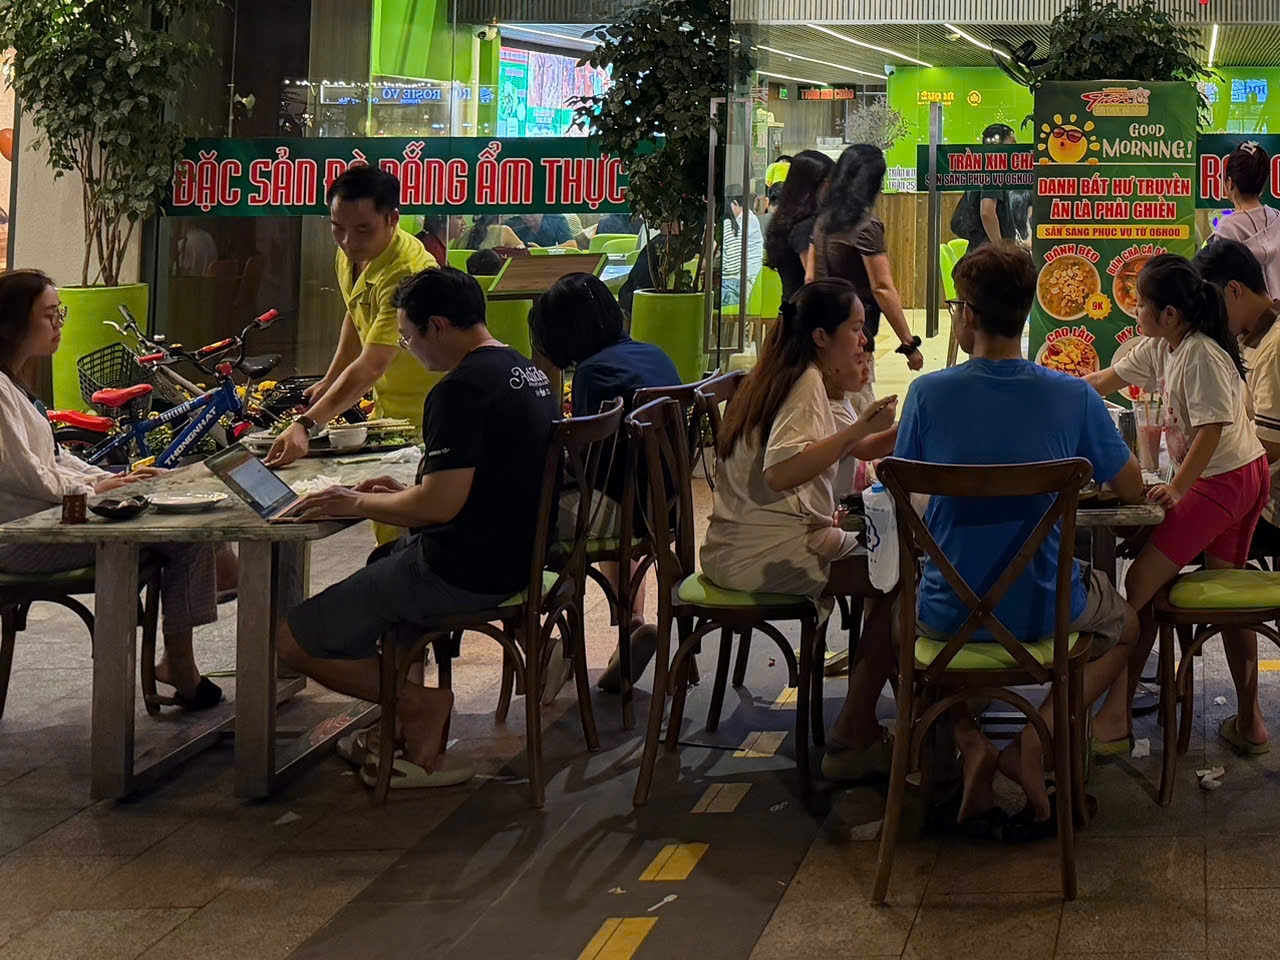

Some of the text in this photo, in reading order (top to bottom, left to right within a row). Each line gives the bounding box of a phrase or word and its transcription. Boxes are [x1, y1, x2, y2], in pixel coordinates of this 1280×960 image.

[947, 147, 983, 171] TRẦN
[985, 152, 1008, 171] XIN
[1102, 137, 1193, 159] MORNING!
[172, 149, 242, 212] ĐẶC
[248, 146, 317, 206] SẢN
[475, 141, 534, 205] ẨM
[541, 153, 629, 210] THỰC
[1038, 177, 1078, 196] DANH
[1080, 172, 1110, 196] BẤT
[1112, 175, 1136, 196] HƯ
[1137, 173, 1192, 197] TRUYỀN
[1050, 198, 1071, 219] ĂN
[1074, 198, 1093, 219] LÀ
[1094, 197, 1130, 220] PHẢI
[1092, 301, 1104, 311] 9K
